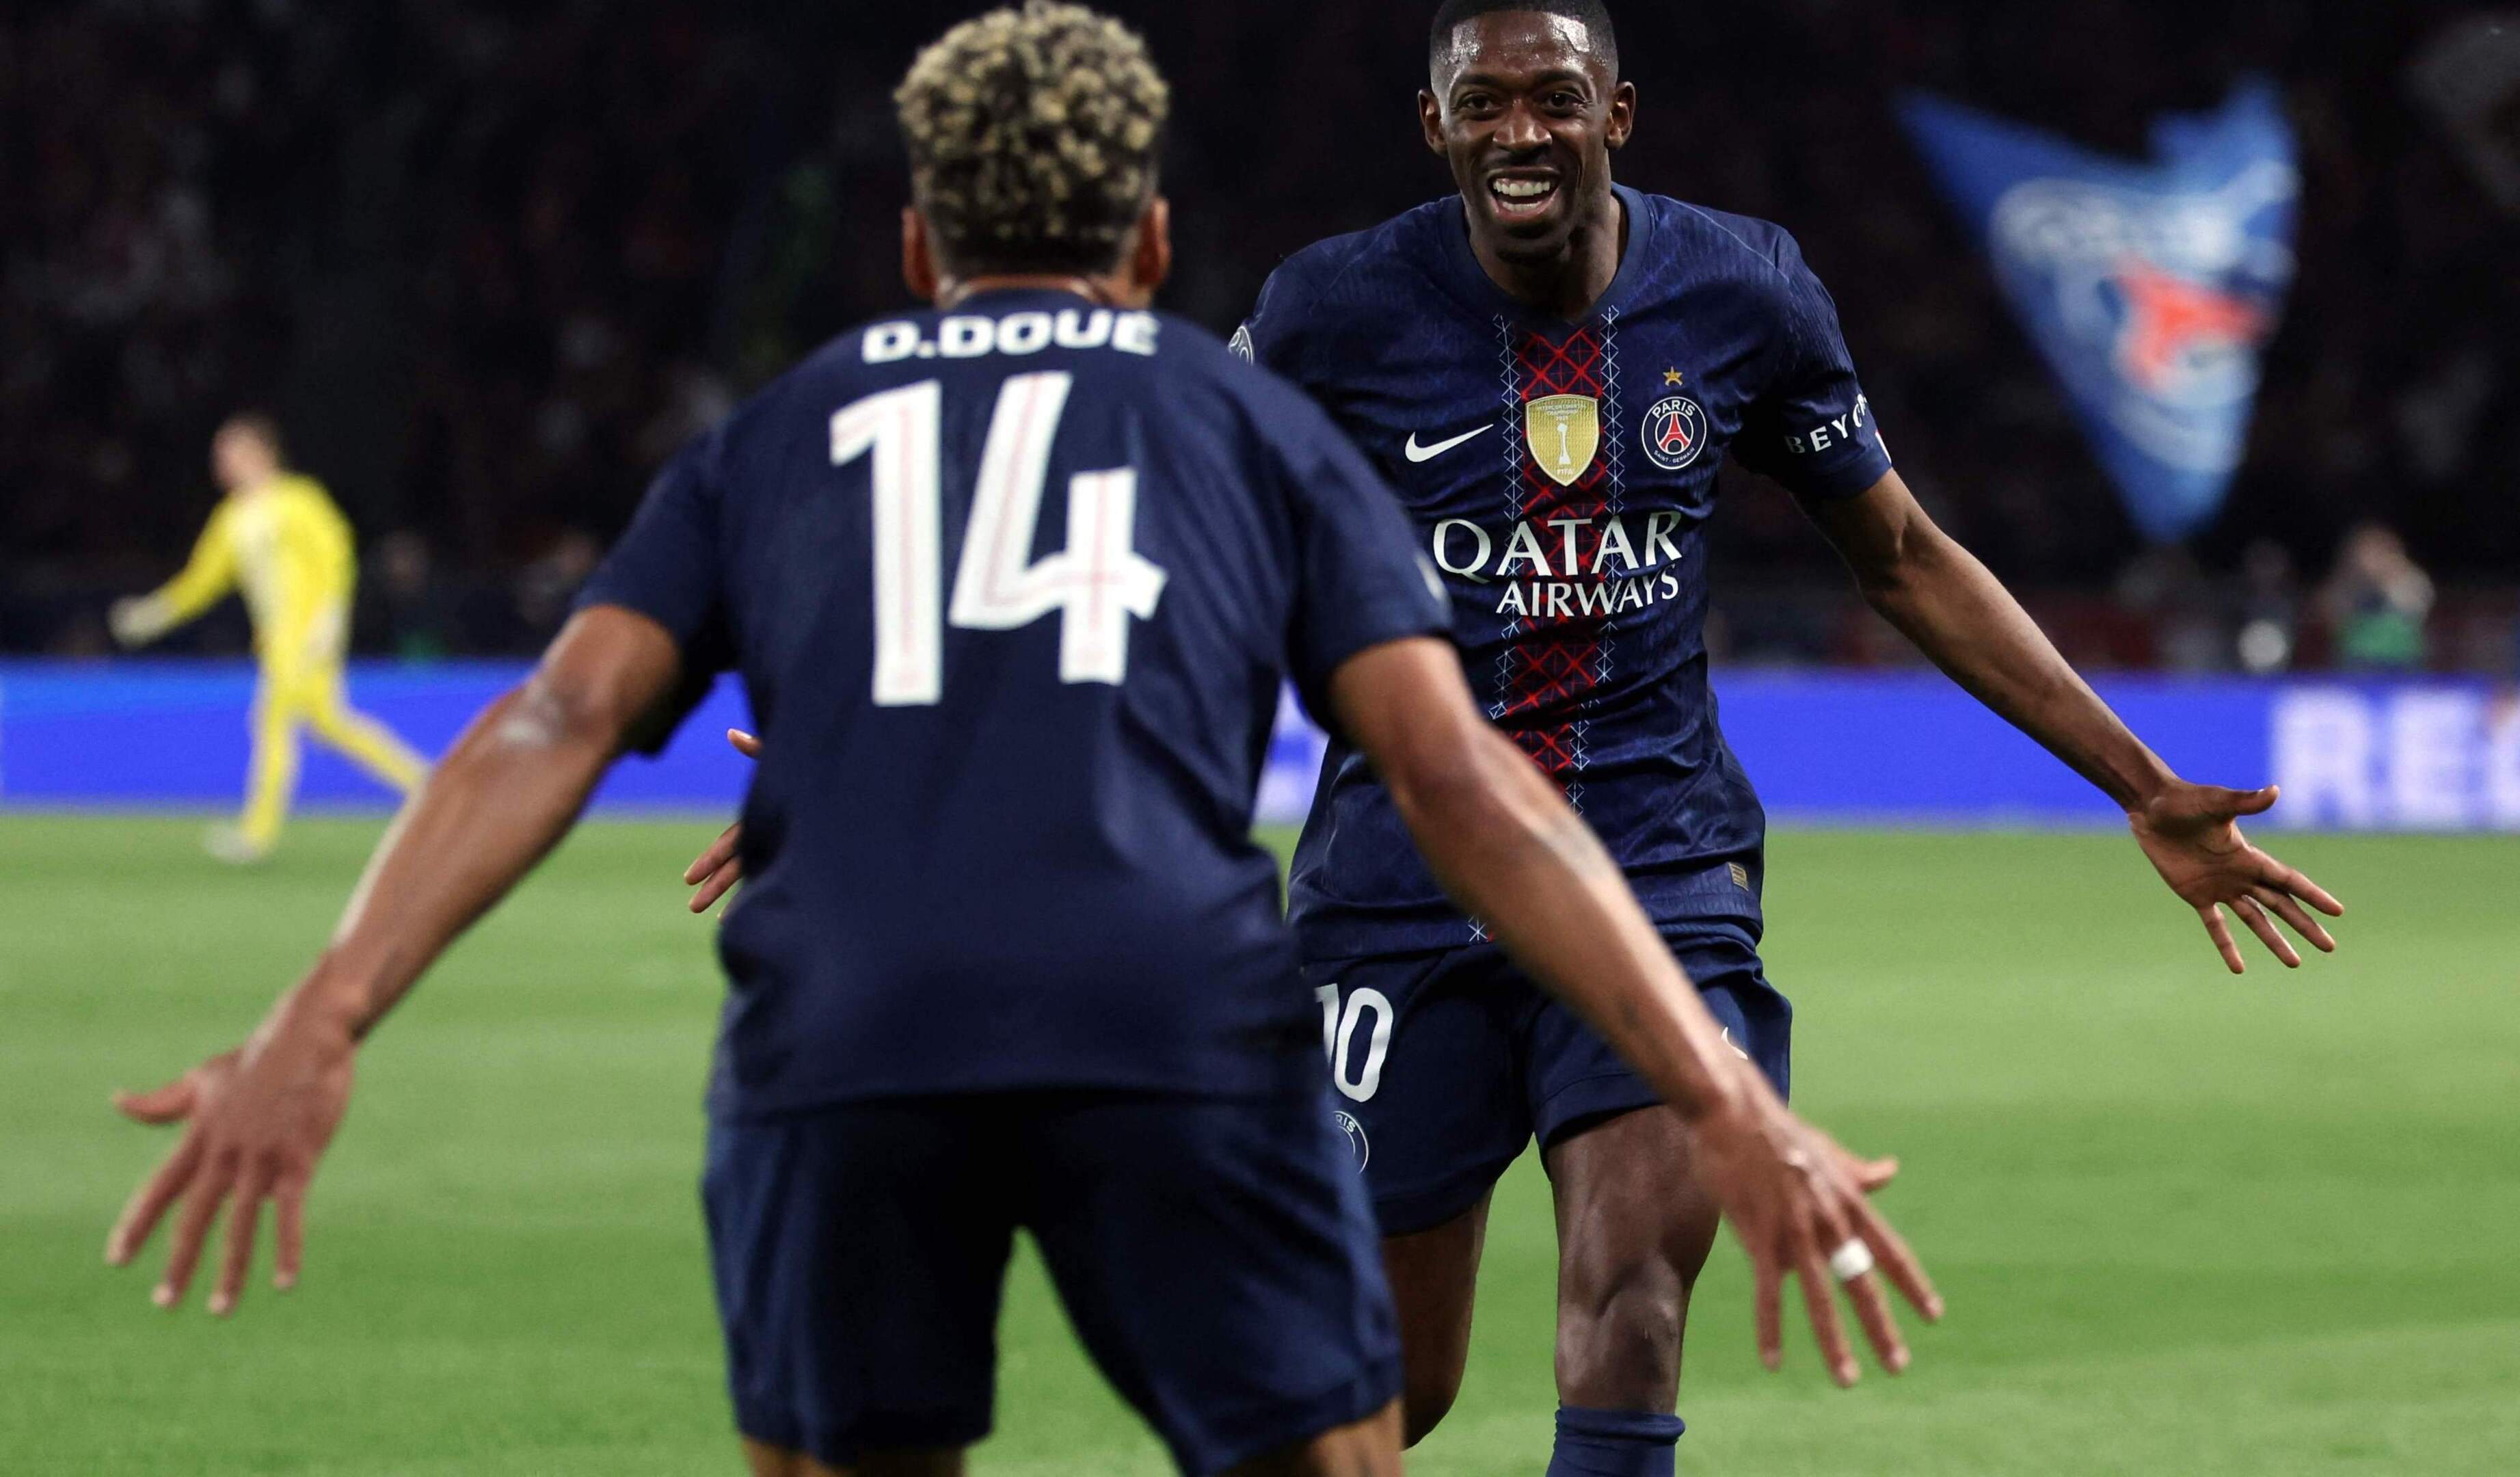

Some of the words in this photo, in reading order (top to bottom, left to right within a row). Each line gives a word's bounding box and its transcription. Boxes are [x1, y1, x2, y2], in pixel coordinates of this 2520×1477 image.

[1652, 399, 1695, 418] PARIS
[829, 370, 1168, 706] 14
[1433, 511, 1683, 584] QATAR
[1495, 564, 1679, 617] AIRWAYS
[1313, 983, 1394, 1103] 10
[1335, 1114, 1356, 1133] RIS
